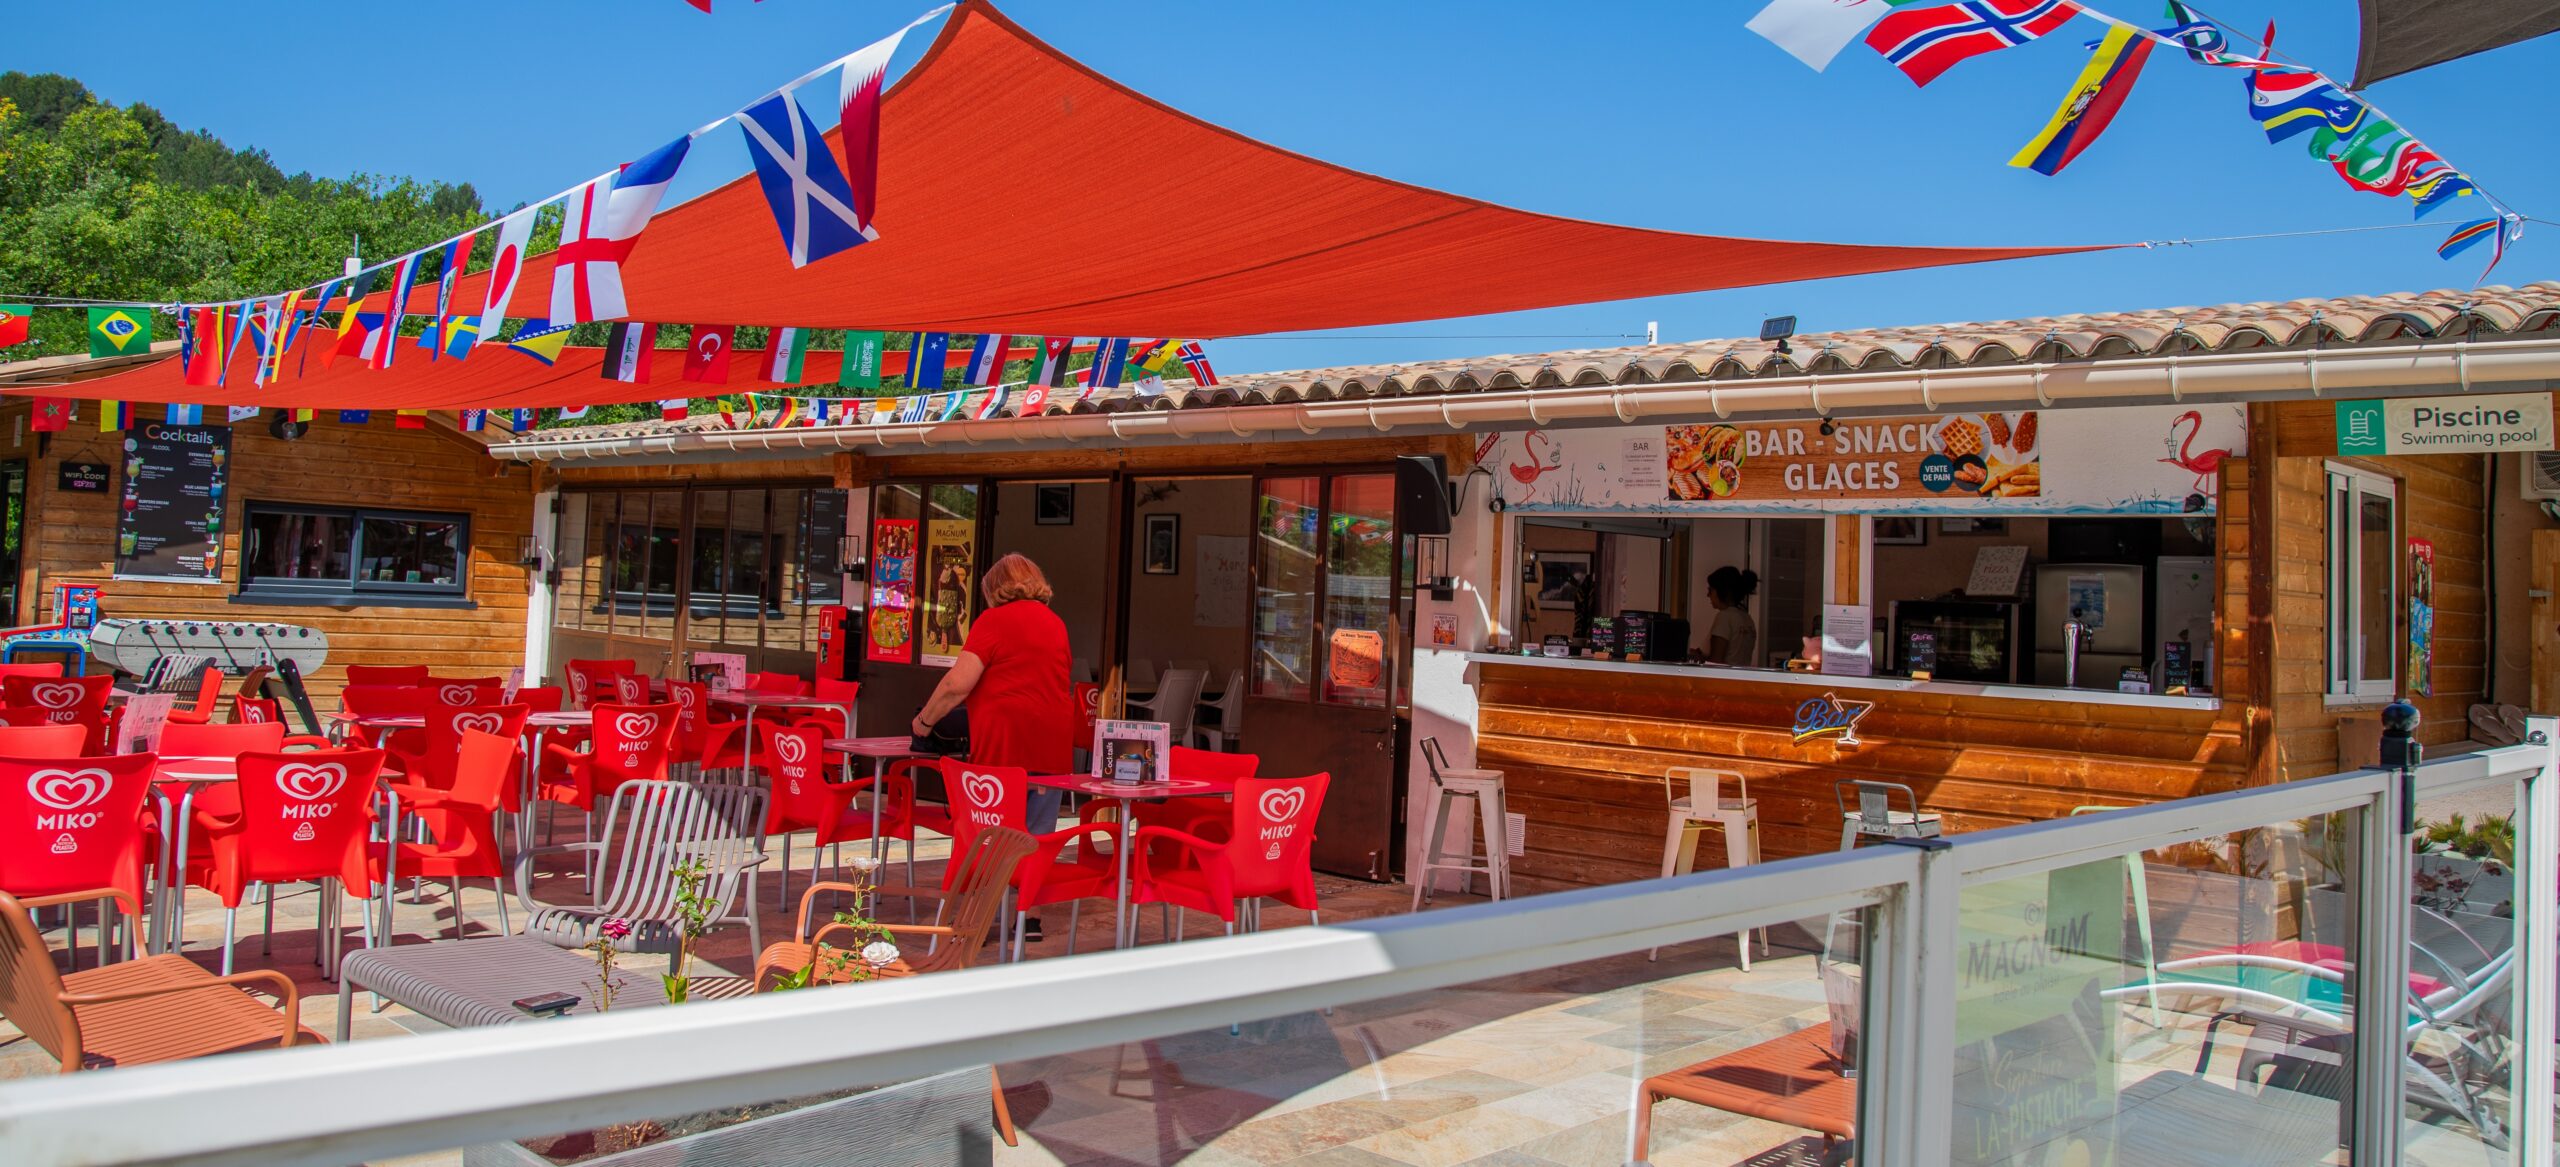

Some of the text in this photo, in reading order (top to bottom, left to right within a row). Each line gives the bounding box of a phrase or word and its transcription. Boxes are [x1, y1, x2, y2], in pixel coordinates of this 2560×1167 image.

[2413, 405, 2521, 428] Piscine
[145, 424, 214, 444] Cocktails
[1745, 428, 1806, 457] BAR
[1834, 423, 1942, 454] SNACK
[2401, 428, 2537, 446] Swimming pool
[1633, 442, 1649, 450] BAR
[1784, 460, 1900, 491] GLACES
[1924, 465, 1948, 474] VENTE
[935, 529, 967, 537] MAGNUM
[1792, 698, 1860, 733] Bar
[1104, 741, 1114, 775] Cocktails
[1964, 911, 2090, 989] MAGNUM
